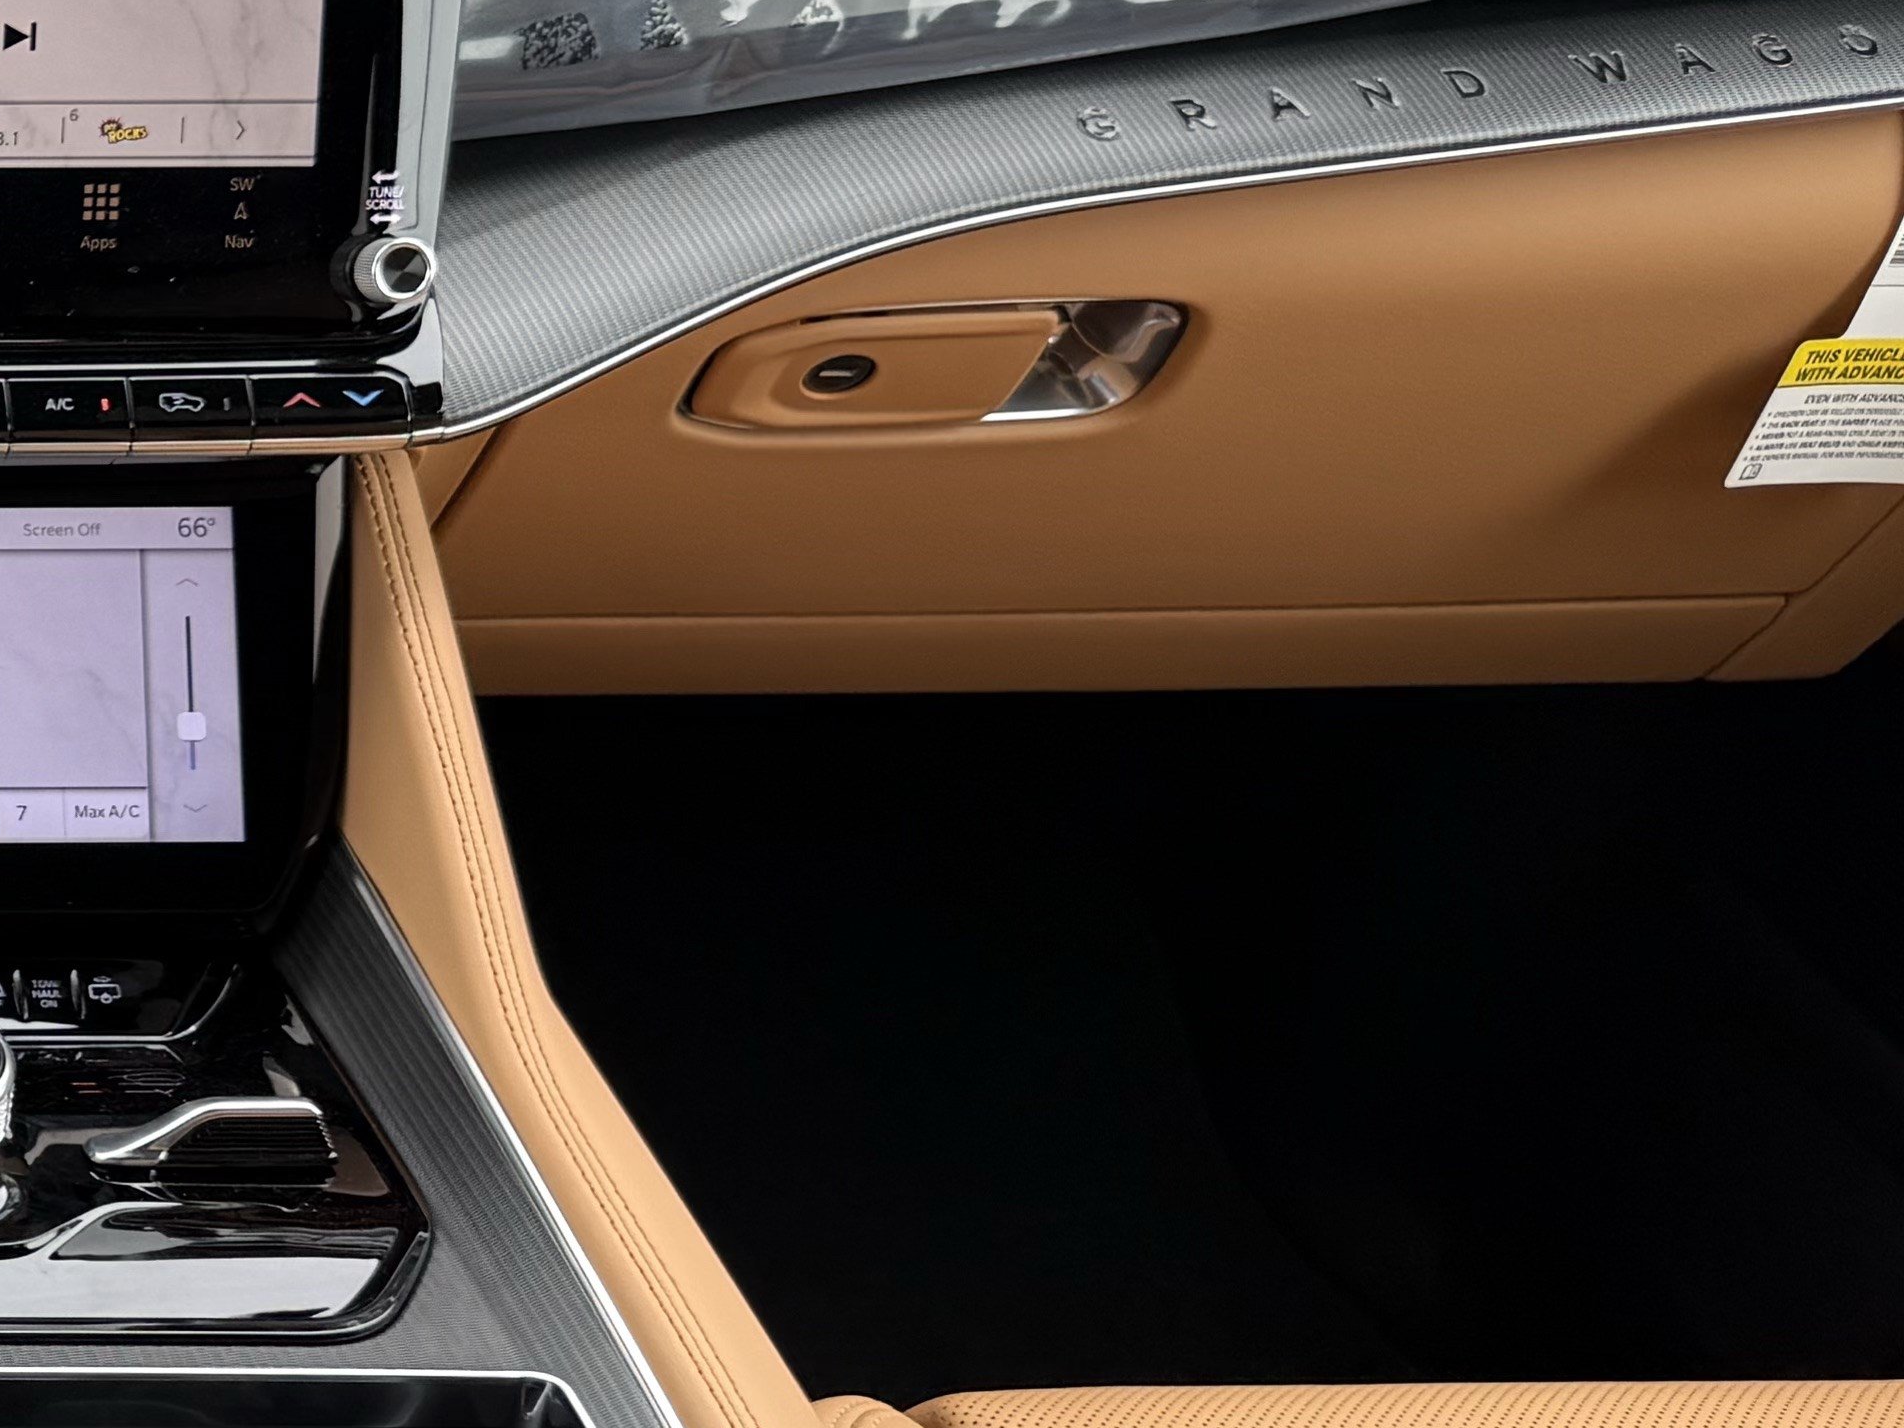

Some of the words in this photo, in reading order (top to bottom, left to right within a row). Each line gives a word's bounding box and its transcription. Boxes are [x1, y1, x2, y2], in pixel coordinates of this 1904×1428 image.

[1075, 68, 1488, 143] GRAND
[1569, 22, 1882, 85] WAGO
[69, 108, 79, 122] 6
[229, 177, 255, 193] SW
[79, 236, 118, 254] Apps
[224, 234, 254, 250] Nav
[1804, 349, 1842, 365] THIS
[1794, 367, 1835, 382] WITH
[44, 397, 76, 412] A/C
[22, 522, 75, 538] Screen
[77, 521, 103, 538] Off
[177, 516, 218, 539] 66°
[16, 805, 28, 821] 7
[73, 804, 107, 820] Max
[108, 804, 141, 820] A/C
[40, 999, 59, 1009] ON
